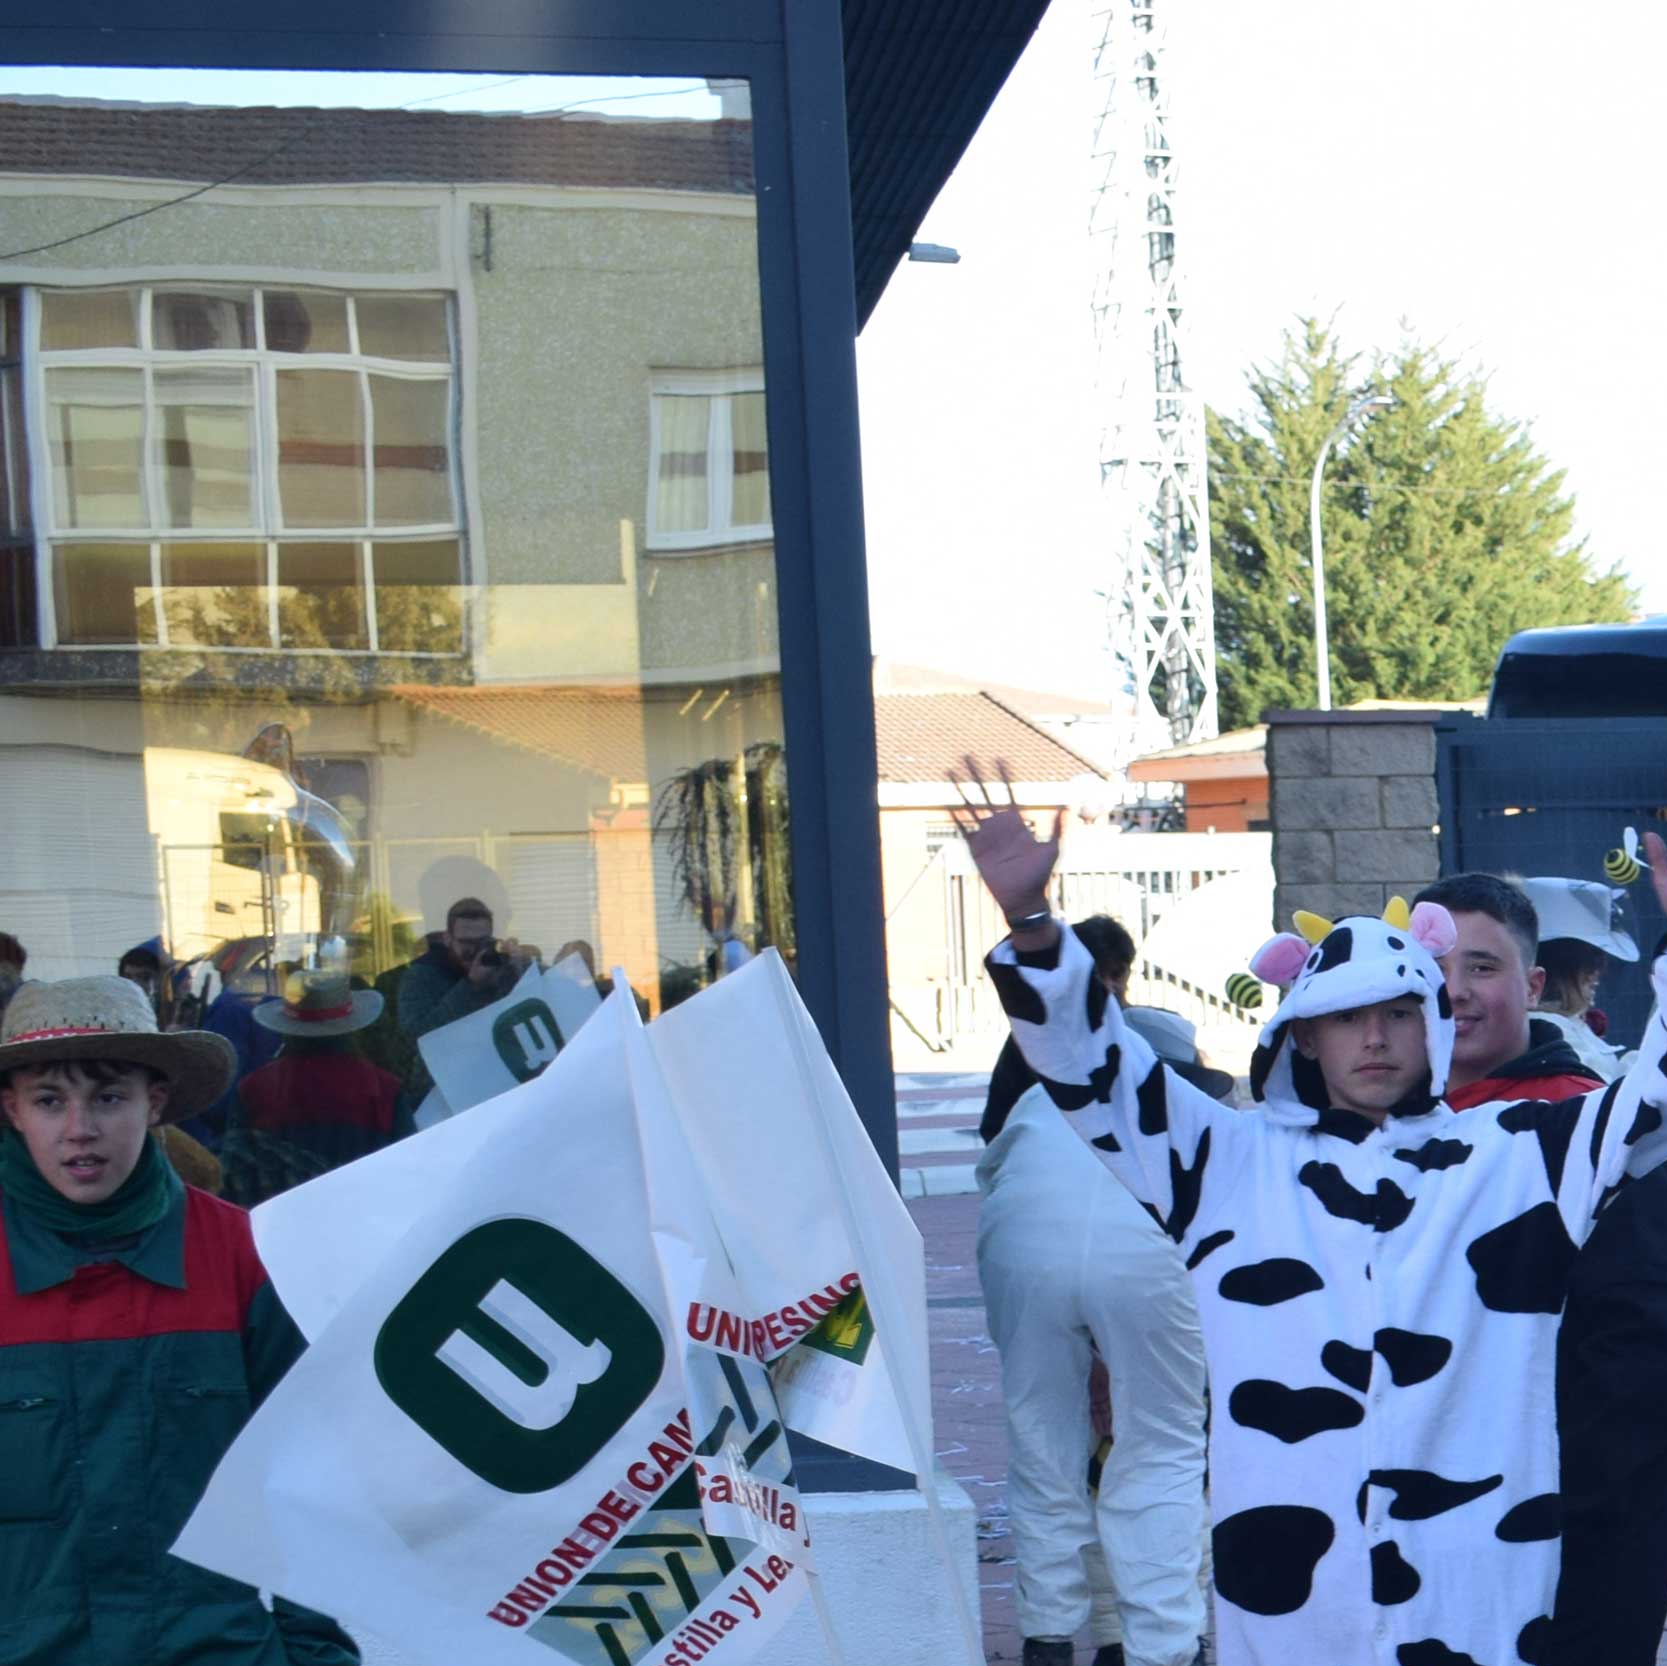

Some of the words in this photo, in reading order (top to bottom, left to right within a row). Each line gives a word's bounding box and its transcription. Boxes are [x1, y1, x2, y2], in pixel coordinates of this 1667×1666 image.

[486, 1536, 596, 1628] UNION
[579, 1489, 642, 1543] DE
[743, 1554, 795, 1594] Le
[728, 1585, 762, 1620] y
